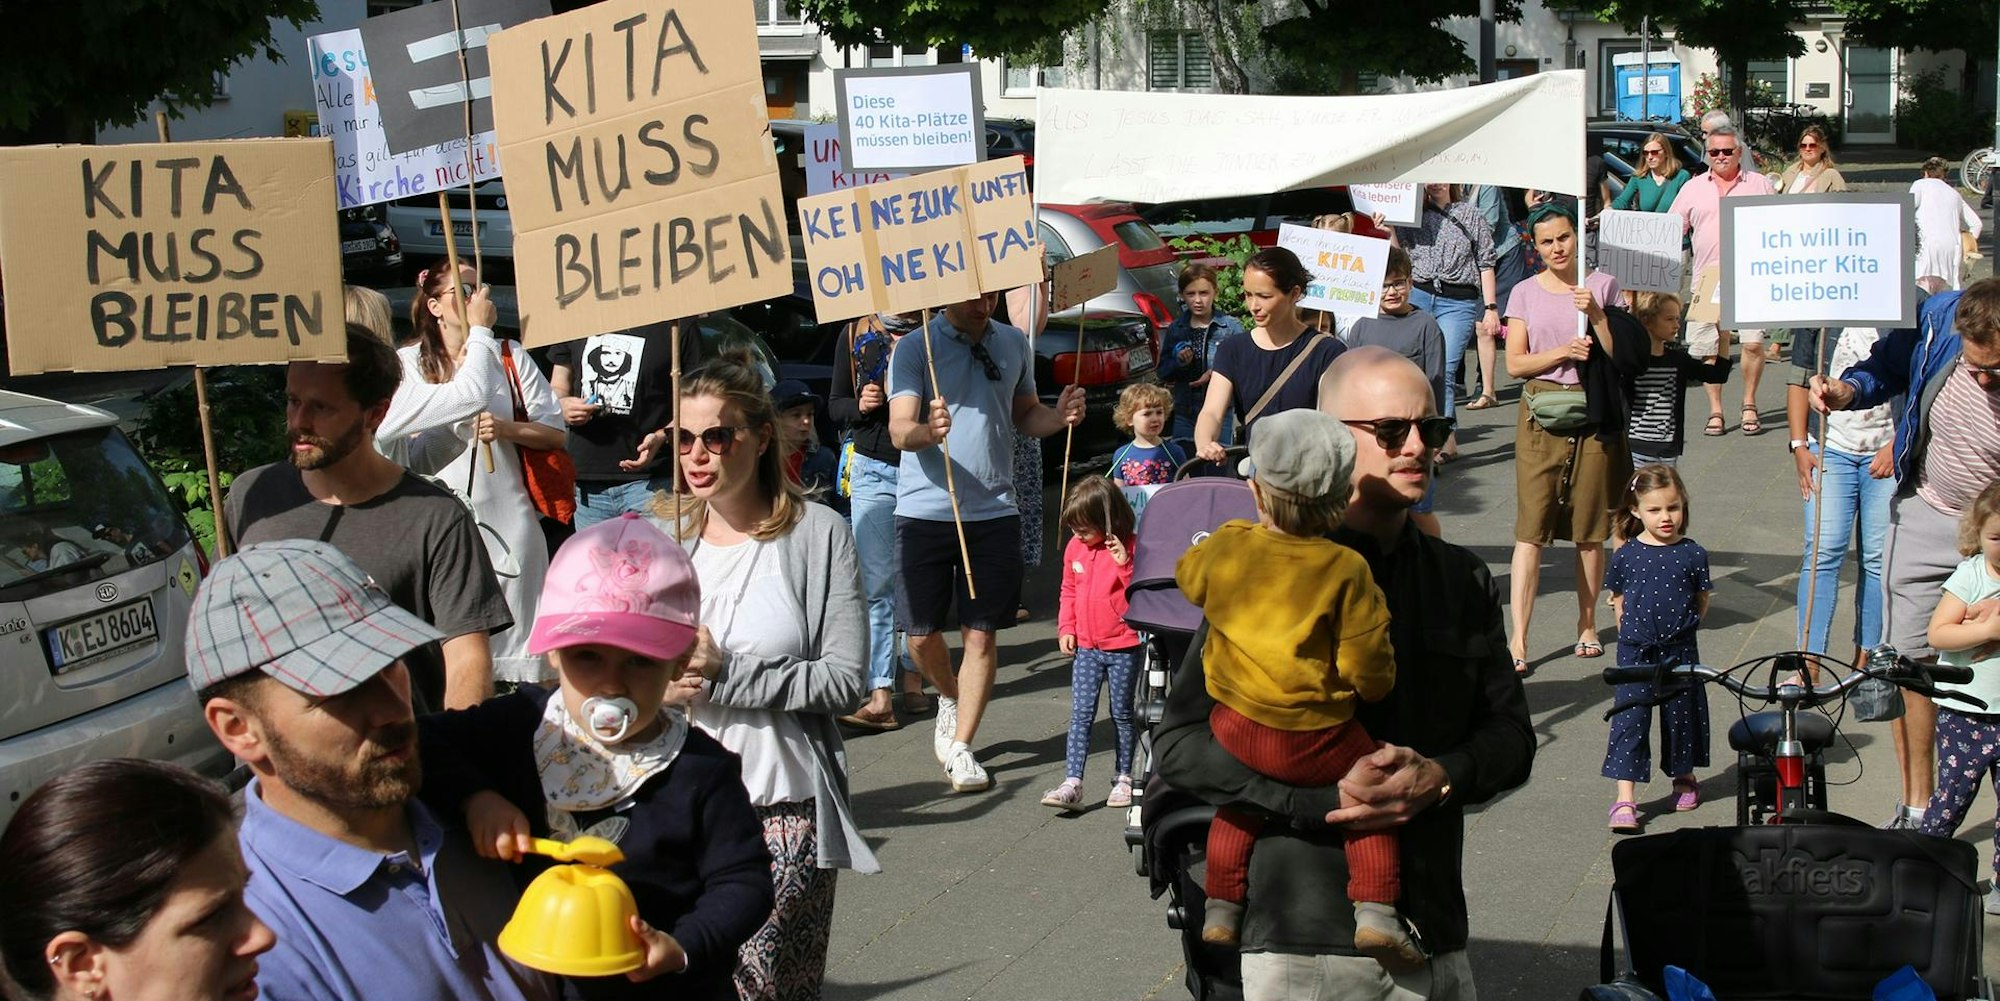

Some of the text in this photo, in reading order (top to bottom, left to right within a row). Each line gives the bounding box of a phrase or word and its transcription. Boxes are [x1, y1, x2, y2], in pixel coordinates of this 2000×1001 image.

[541, 8, 709, 125] KITA
[318, 83, 353, 109] Alle
[852, 95, 895, 109] Diese
[344, 117, 367, 132] mir
[855, 112, 968, 129] 40 Kita-Plätze
[856, 130, 972, 147] müssen bleiben!
[336, 154, 357, 169] as
[813, 138, 840, 163] UN
[546, 114, 720, 212] MUSS
[82, 155, 255, 218] KITA
[337, 165, 425, 208] Kirche
[1368, 191, 1401, 204] leben!
[1761, 227, 1867, 248] Ich will in
[87, 229, 264, 285] MUSS
[555, 196, 785, 310] BLEIBEN
[1317, 251, 1365, 273] KITA
[1750, 254, 1879, 276] meiner Kita
[1770, 281, 1859, 302] bleiben!
[91, 290, 323, 348] BLEIBEN
[97, 586, 116, 599] KIA
[59, 629, 74, 659] K
[1735, 857, 1864, 896] akfiets
